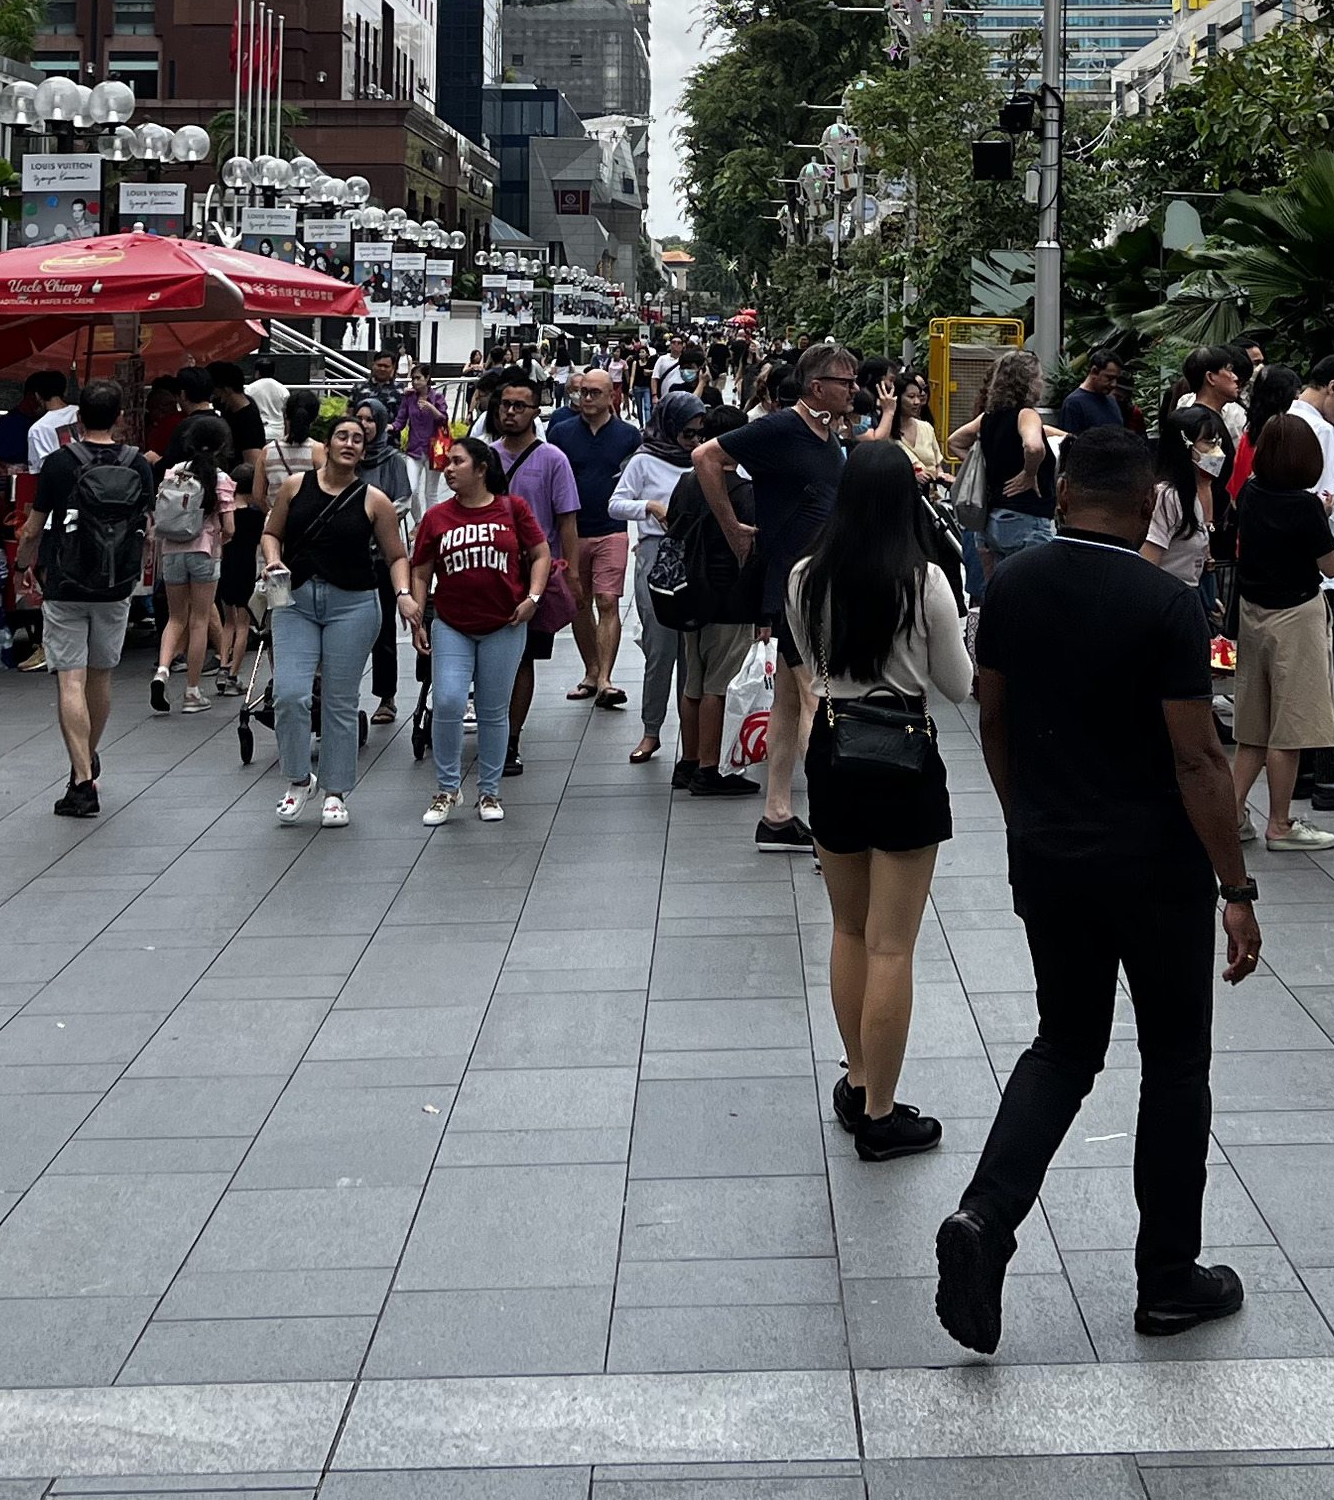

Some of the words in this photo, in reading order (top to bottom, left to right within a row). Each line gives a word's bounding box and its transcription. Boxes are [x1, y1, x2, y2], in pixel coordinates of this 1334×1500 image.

[31, 162, 55, 170] LOUIS
[57, 162, 92, 170] VUITTON
[8, 279, 43, 293] Uncle
[443, 545, 508, 576] EDITION
